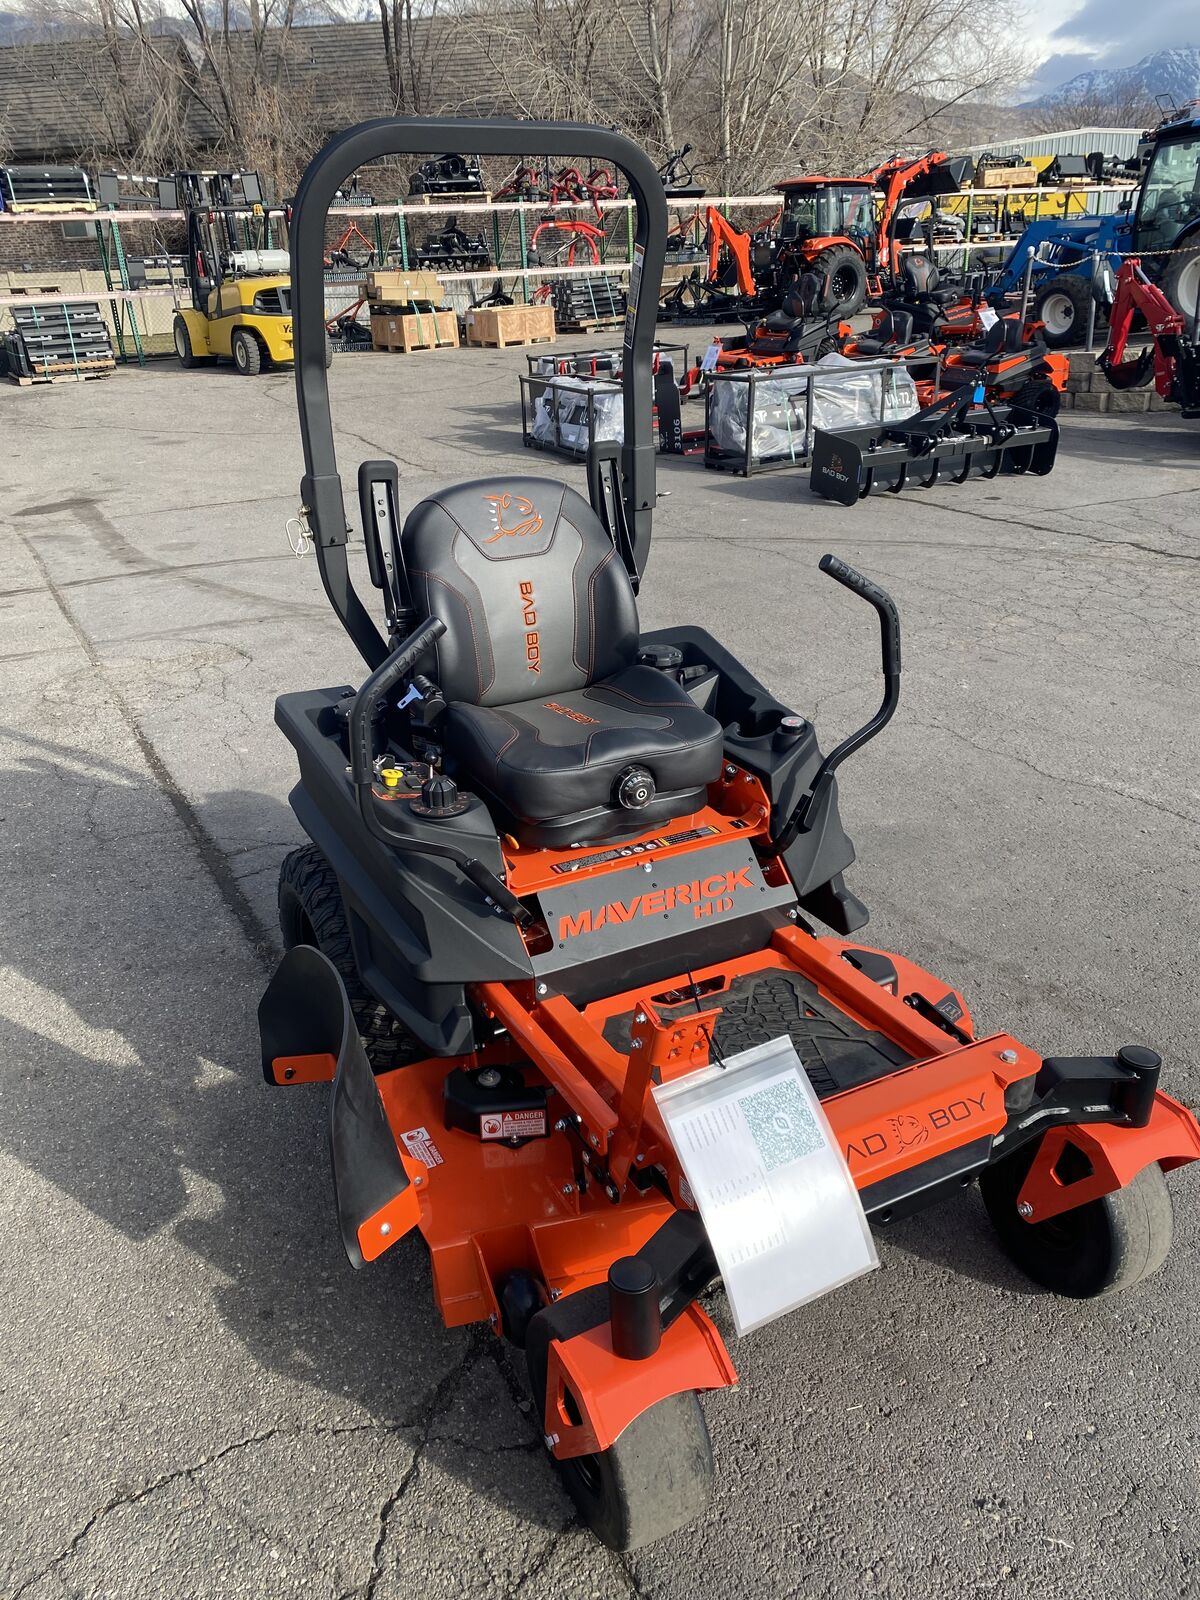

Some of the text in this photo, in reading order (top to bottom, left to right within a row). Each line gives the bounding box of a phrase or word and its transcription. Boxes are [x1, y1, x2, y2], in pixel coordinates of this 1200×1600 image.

[674, 418, 682, 449] 3106
[822, 466, 850, 483] BAD BOY
[519, 581, 541, 673] BAD BOY
[559, 866, 755, 941] MAVERICK
[694, 897, 734, 920] HD
[514, 1111, 544, 1120] DANGER
[846, 1092, 986, 1166] AD BOY
[428, 1145, 444, 1165] DANGER
